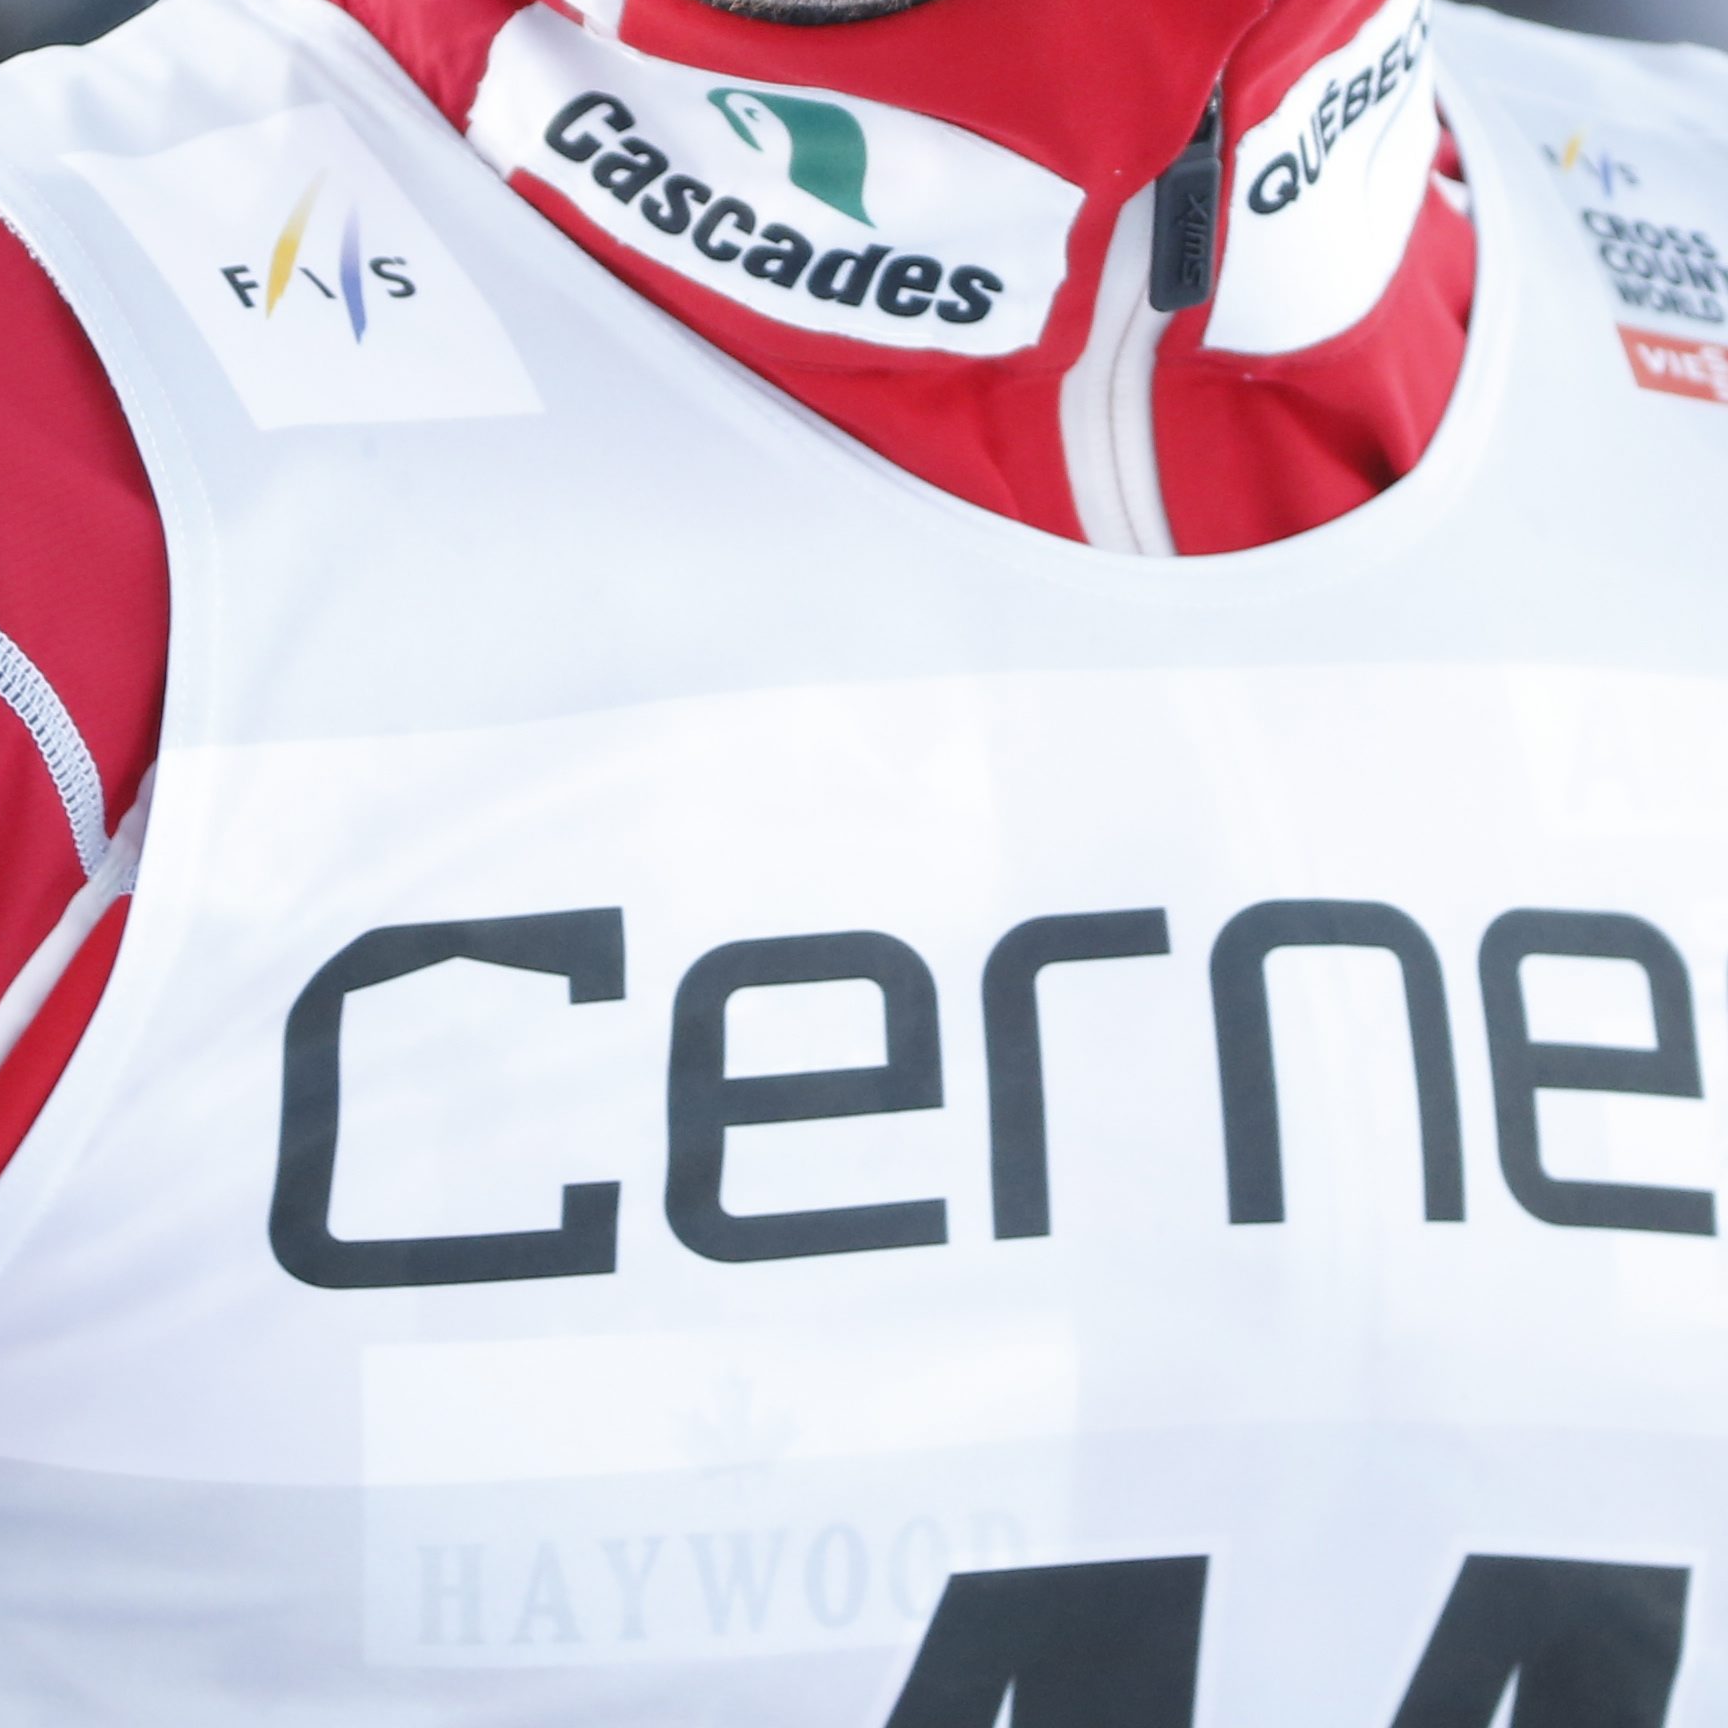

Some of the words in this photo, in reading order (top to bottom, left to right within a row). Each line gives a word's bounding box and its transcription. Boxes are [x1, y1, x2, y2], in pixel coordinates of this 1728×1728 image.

[543, 89, 1005, 325] Cascades
[1580, 206, 1718, 260] CROSS
[218, 255, 417, 309] FIS
[1614, 279, 1726, 324] WORLD
